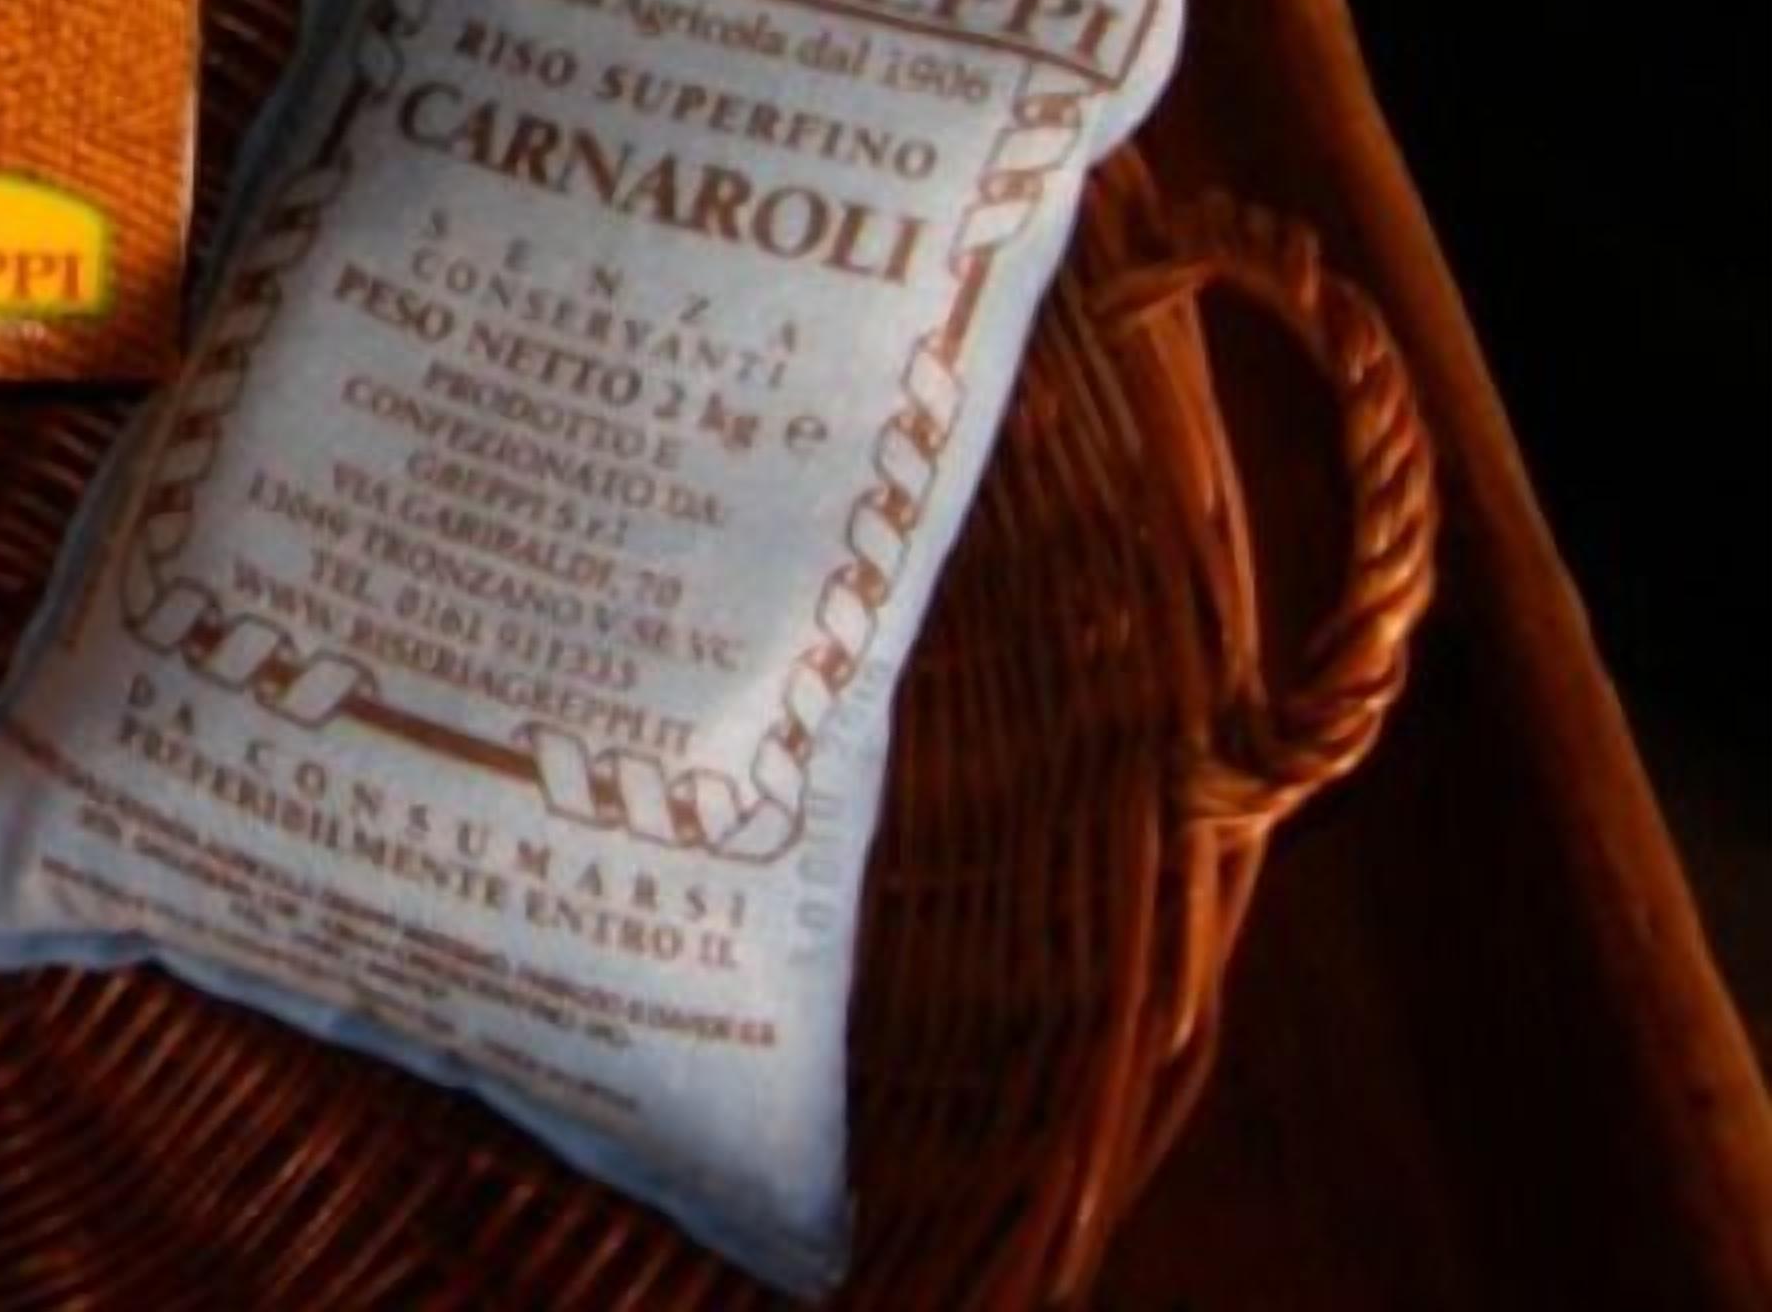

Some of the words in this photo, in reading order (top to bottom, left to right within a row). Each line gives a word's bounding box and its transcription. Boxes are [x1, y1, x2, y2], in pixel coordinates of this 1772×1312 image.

[454, 18, 581, 92] RISO
[601, 65, 941, 183] SUPERFINO
[794, 25, 872, 80] dal
[394, 78, 932, 288] CARNAROLI
[332, 259, 457, 345] PESO
[465, 318, 643, 408] NETTO
[651, 379, 686, 421] 2
[410, 244, 790, 389] CONSERVANTI
[341, 373, 658, 511] CONFEZIONATO
[404, 448, 550, 522] GREPPI
[426, 358, 650, 460] PRODOTTO
[651, 434, 686, 473] E
[116, 713, 508, 912] PREFERIBILMENTE
[525, 878, 696, 970] ENTRO
[246, 732, 752, 928] CONSUMARSI
